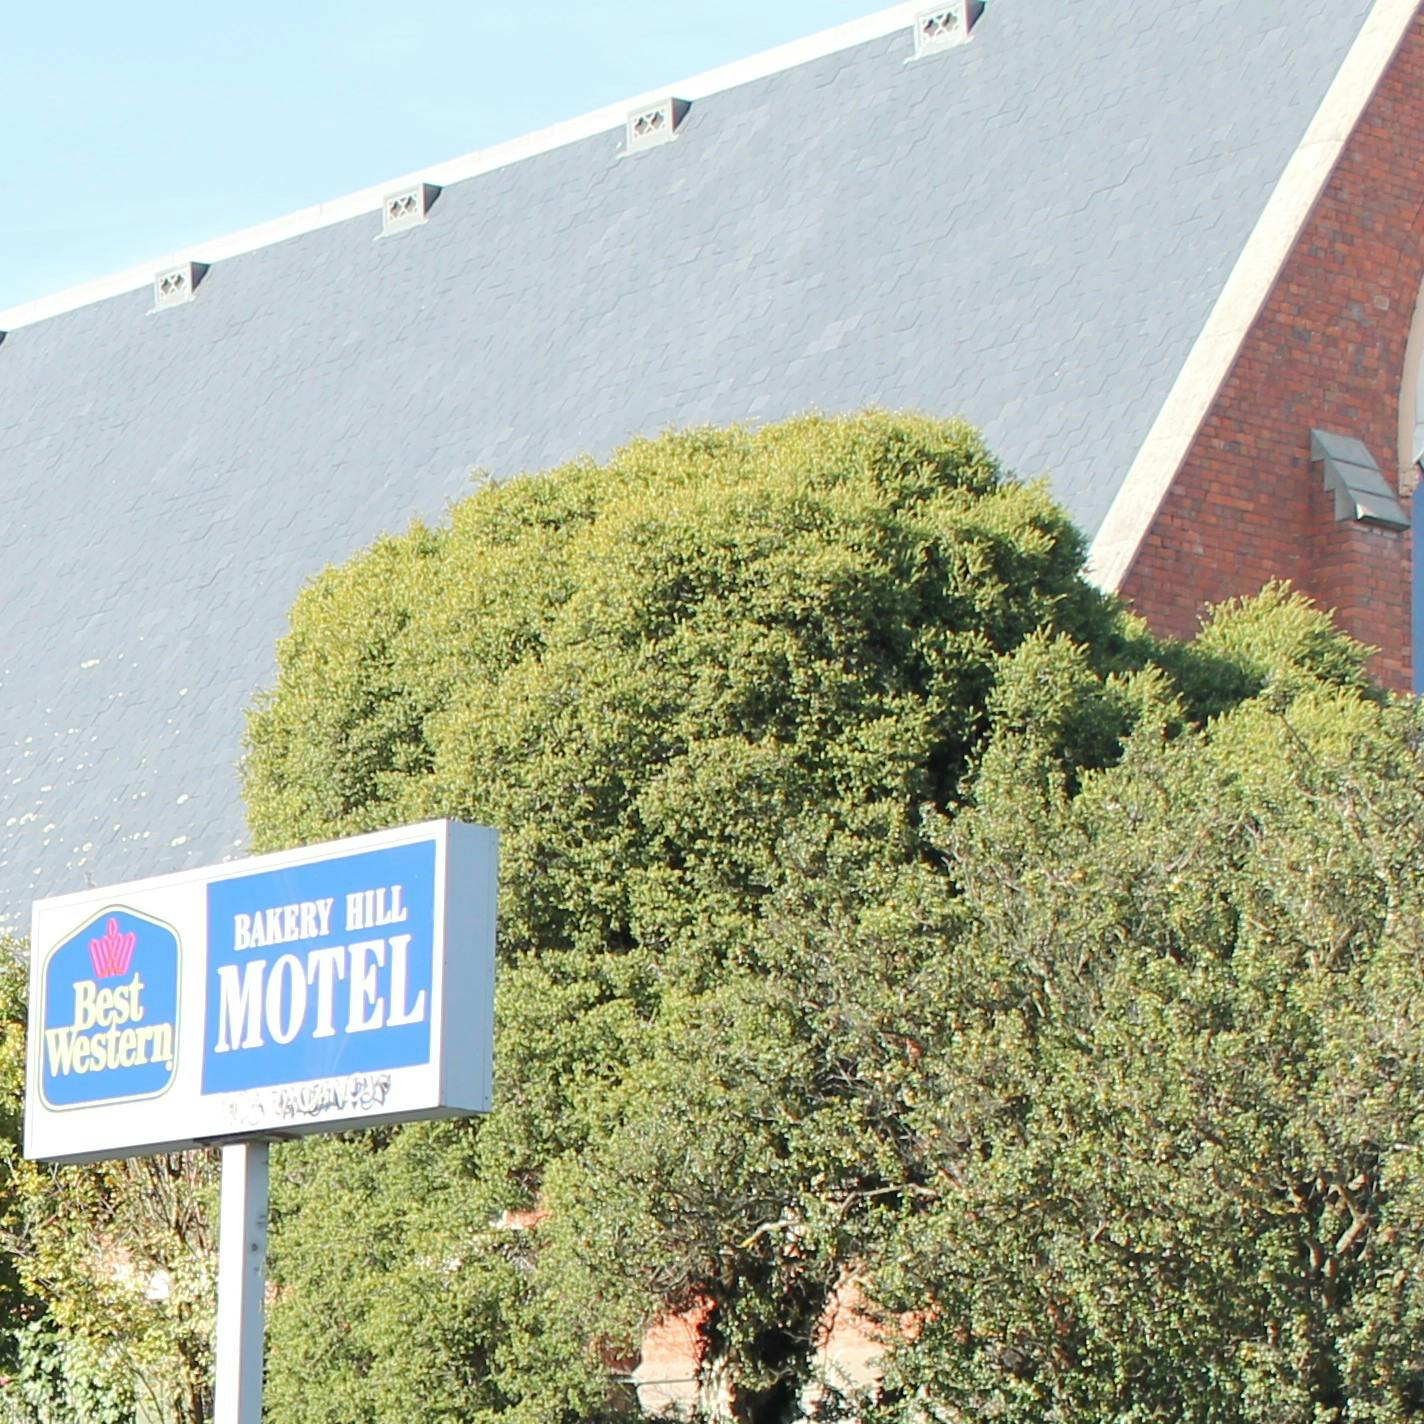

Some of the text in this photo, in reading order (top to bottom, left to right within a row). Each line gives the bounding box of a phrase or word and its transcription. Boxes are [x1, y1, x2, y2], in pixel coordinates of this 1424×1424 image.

[233, 885, 408, 952] BAKERY HILL
[72, 972, 144, 1031] Best
[214, 934, 427, 1054] MOTEL
[45, 1021, 173, 1078] Western
